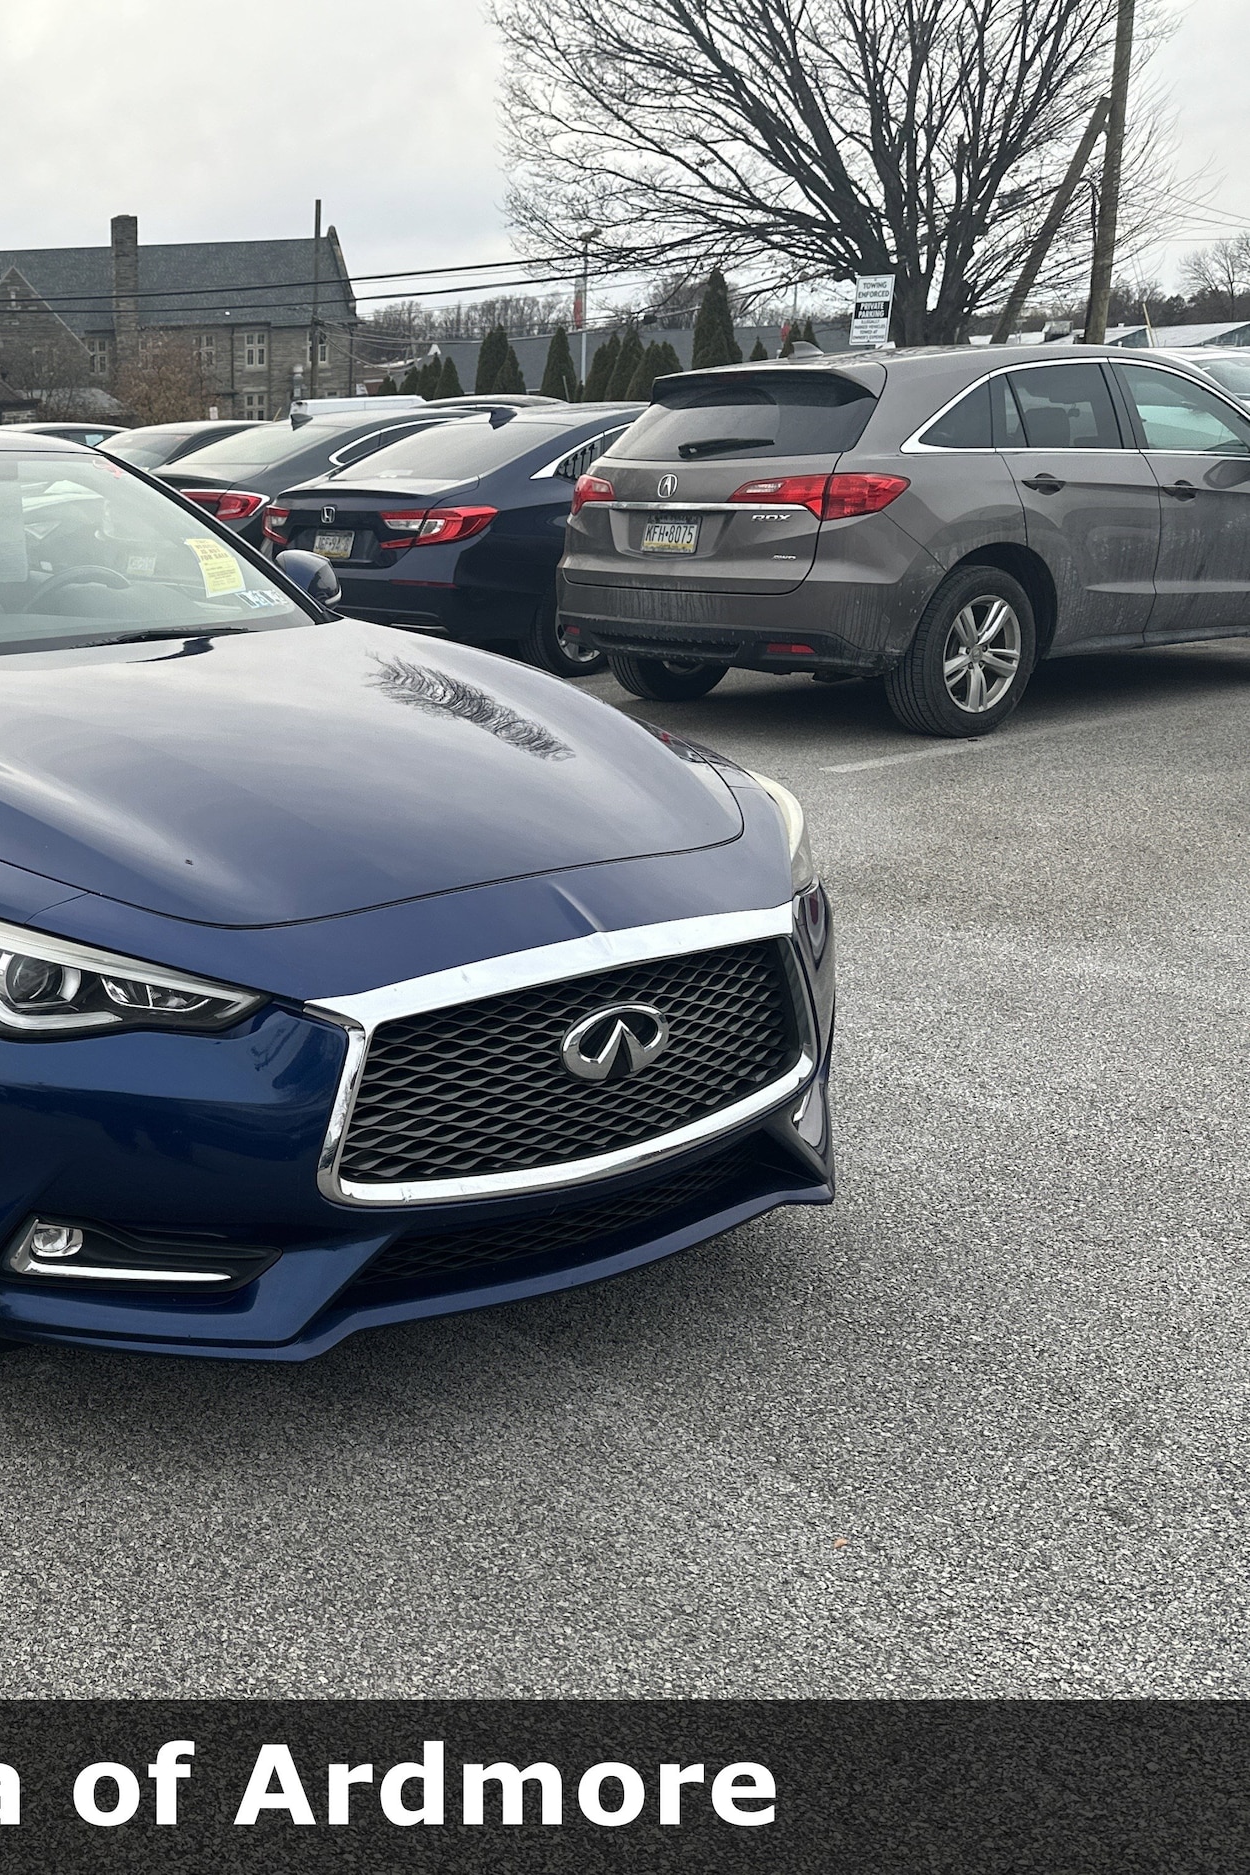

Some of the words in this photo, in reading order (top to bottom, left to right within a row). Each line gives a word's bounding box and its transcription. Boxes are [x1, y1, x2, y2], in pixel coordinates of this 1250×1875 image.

[858, 290, 890, 298] ENFORCED
[860, 302, 885, 310] PRIVATE
[858, 310, 885, 318] PARKING
